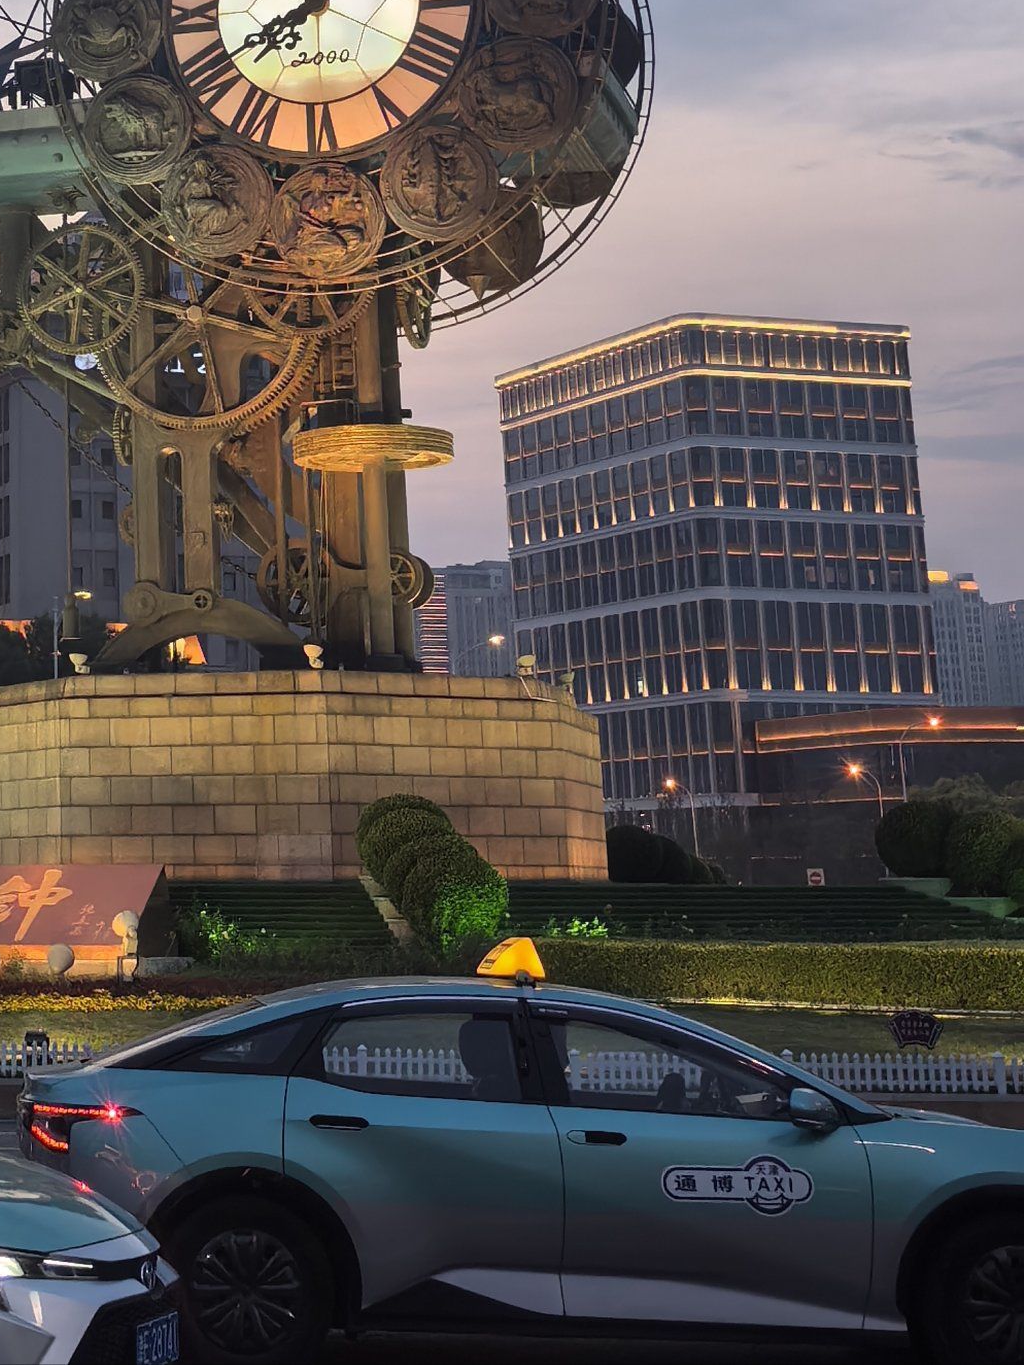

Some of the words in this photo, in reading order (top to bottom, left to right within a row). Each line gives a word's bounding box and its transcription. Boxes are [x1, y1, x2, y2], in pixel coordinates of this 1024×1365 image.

[291, 49, 350, 67] 2000
[755, 1164, 779, 1176] 天津
[674, 1175, 734, 1192] 通博
[744, 1176, 794, 1192] TAXI
